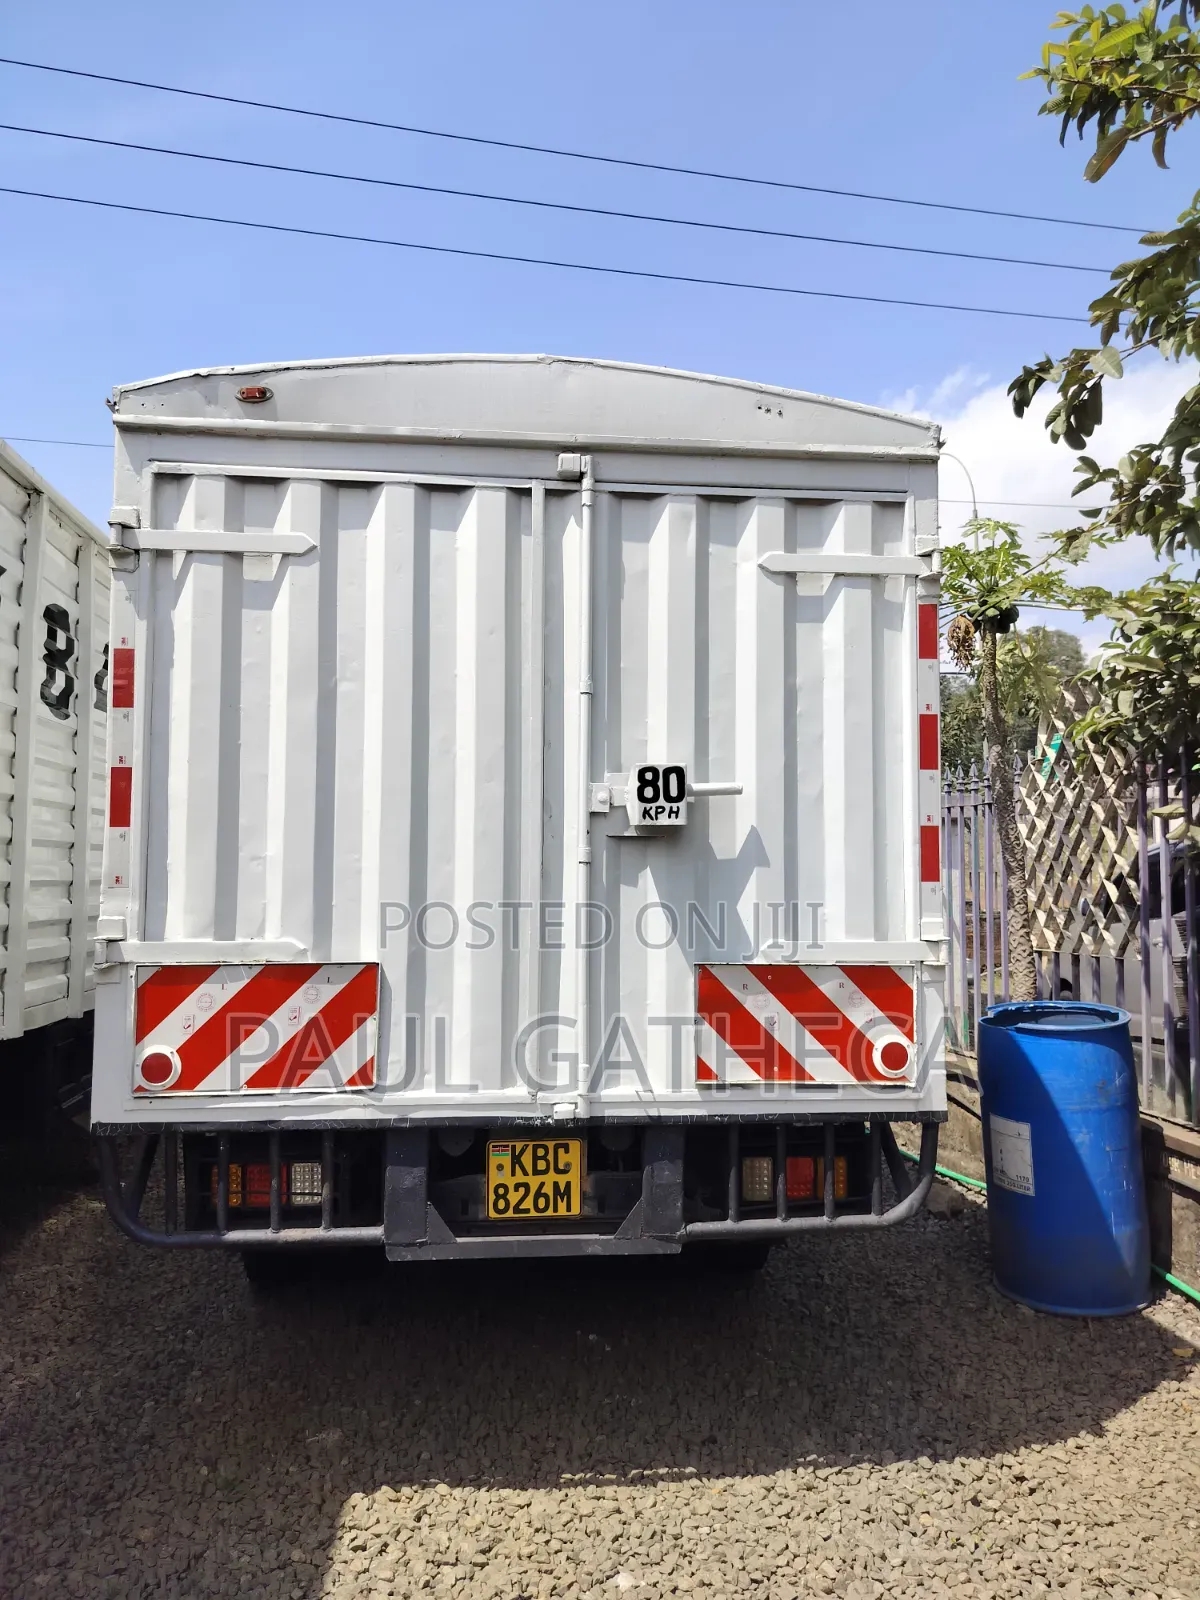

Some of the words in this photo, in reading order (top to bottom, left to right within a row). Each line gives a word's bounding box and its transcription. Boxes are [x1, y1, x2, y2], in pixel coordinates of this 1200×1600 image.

[637, 765, 686, 804] 80
[642, 805, 680, 821] KPH
[510, 1143, 573, 1177] KBC
[492, 1181, 573, 1215] 826M
